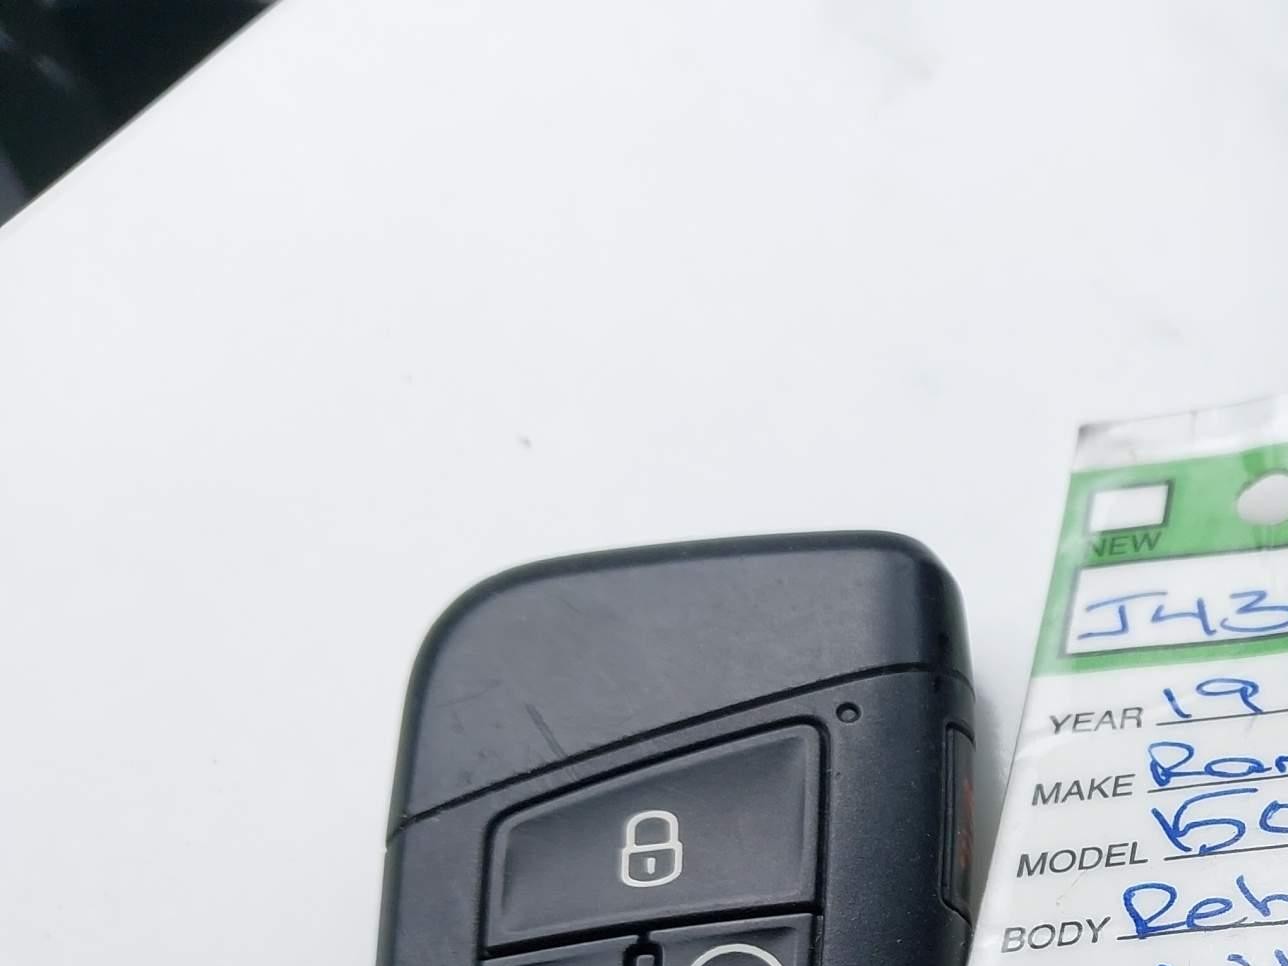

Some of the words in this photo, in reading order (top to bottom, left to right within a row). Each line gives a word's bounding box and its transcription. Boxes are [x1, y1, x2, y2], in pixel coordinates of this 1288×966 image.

[1093, 531, 1162, 557] NEW
[1163, 678, 1263, 719] 19
[1050, 707, 1144, 735] YEAR
[1031, 775, 1136, 806] MAKE
[1016, 842, 1149, 878] MODEL
[1001, 917, 1111, 953] BODY
